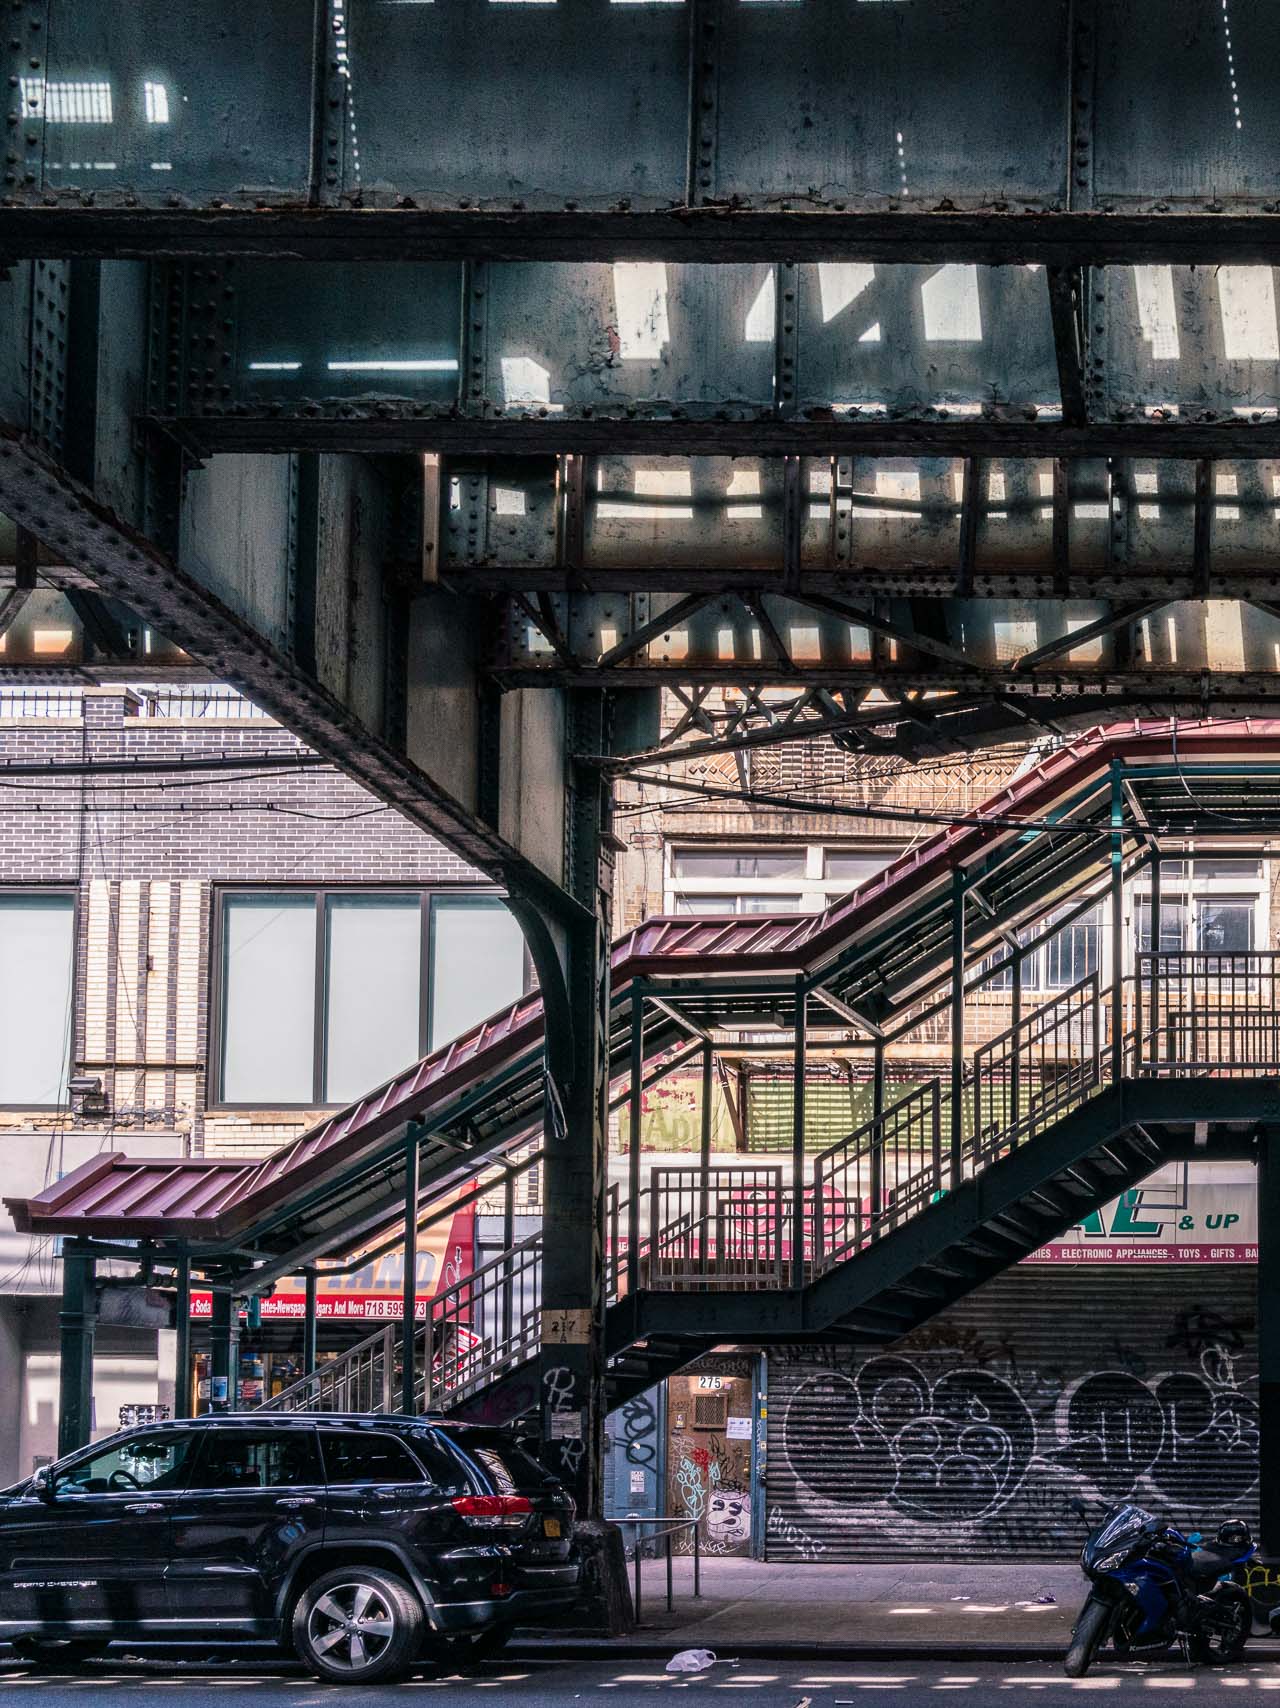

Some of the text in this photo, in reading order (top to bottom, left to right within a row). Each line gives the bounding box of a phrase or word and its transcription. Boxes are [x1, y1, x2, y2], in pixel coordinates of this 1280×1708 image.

[1178, 1215, 1195, 1230] &
[1205, 1214, 1240, 1229] UP
[1061, 1248, 1113, 1259] ELECTRONIC
[1116, 1248, 1168, 1259] APPLIANCES
[1178, 1248, 1200, 1259] TOYS
[1210, 1248, 1235, 1259] GIFTS
[1245, 1248, 1258, 1259] BA
[195, 1299, 212, 1313] Soda
[334, 1301, 346, 1315] And
[348, 1301, 364, 1315] More
[366, 1301, 384, 1315] 718
[700, 1376, 722, 1389] 275
